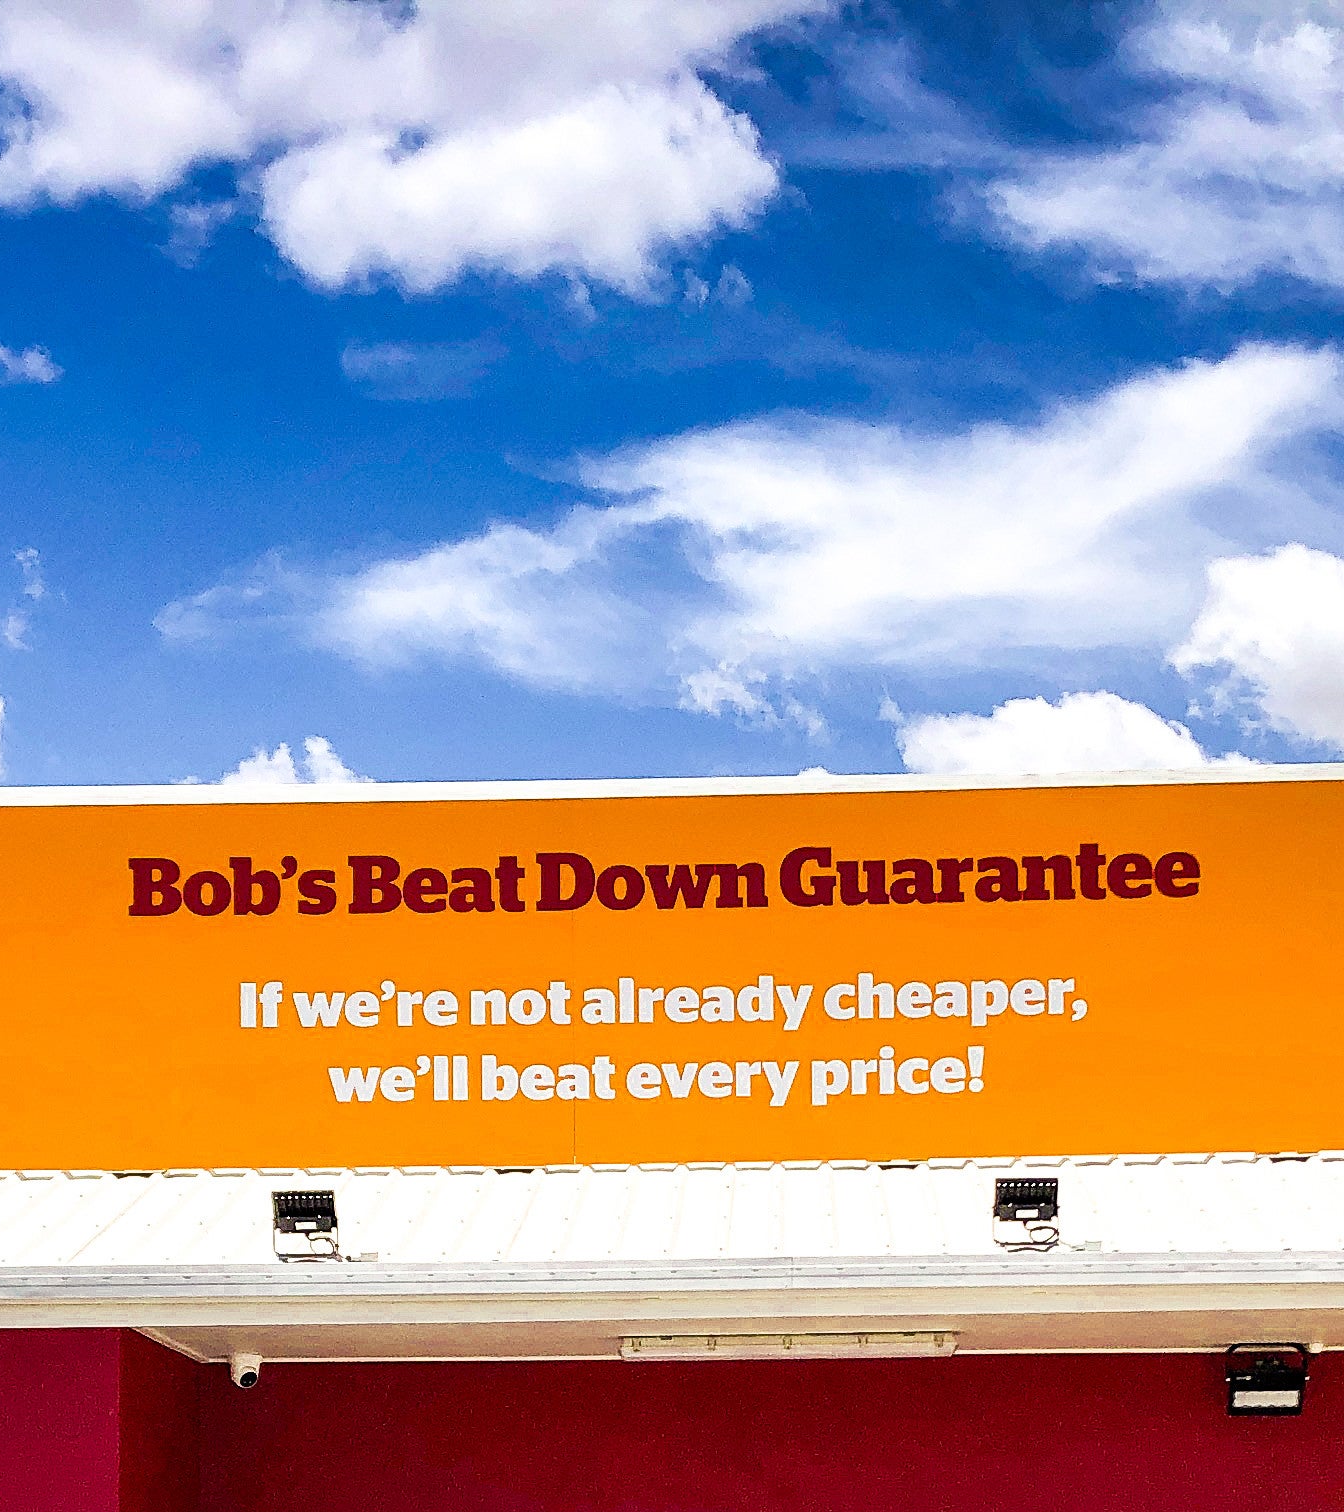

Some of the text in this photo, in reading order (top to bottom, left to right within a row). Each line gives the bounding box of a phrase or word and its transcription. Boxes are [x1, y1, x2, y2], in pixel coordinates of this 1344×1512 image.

[128, 842, 1202, 917] Bob's Beat Down Guarantee
[240, 972, 1088, 1031] If we're not already cheaper,
[328, 1045, 985, 1107] we'll beat every price!
